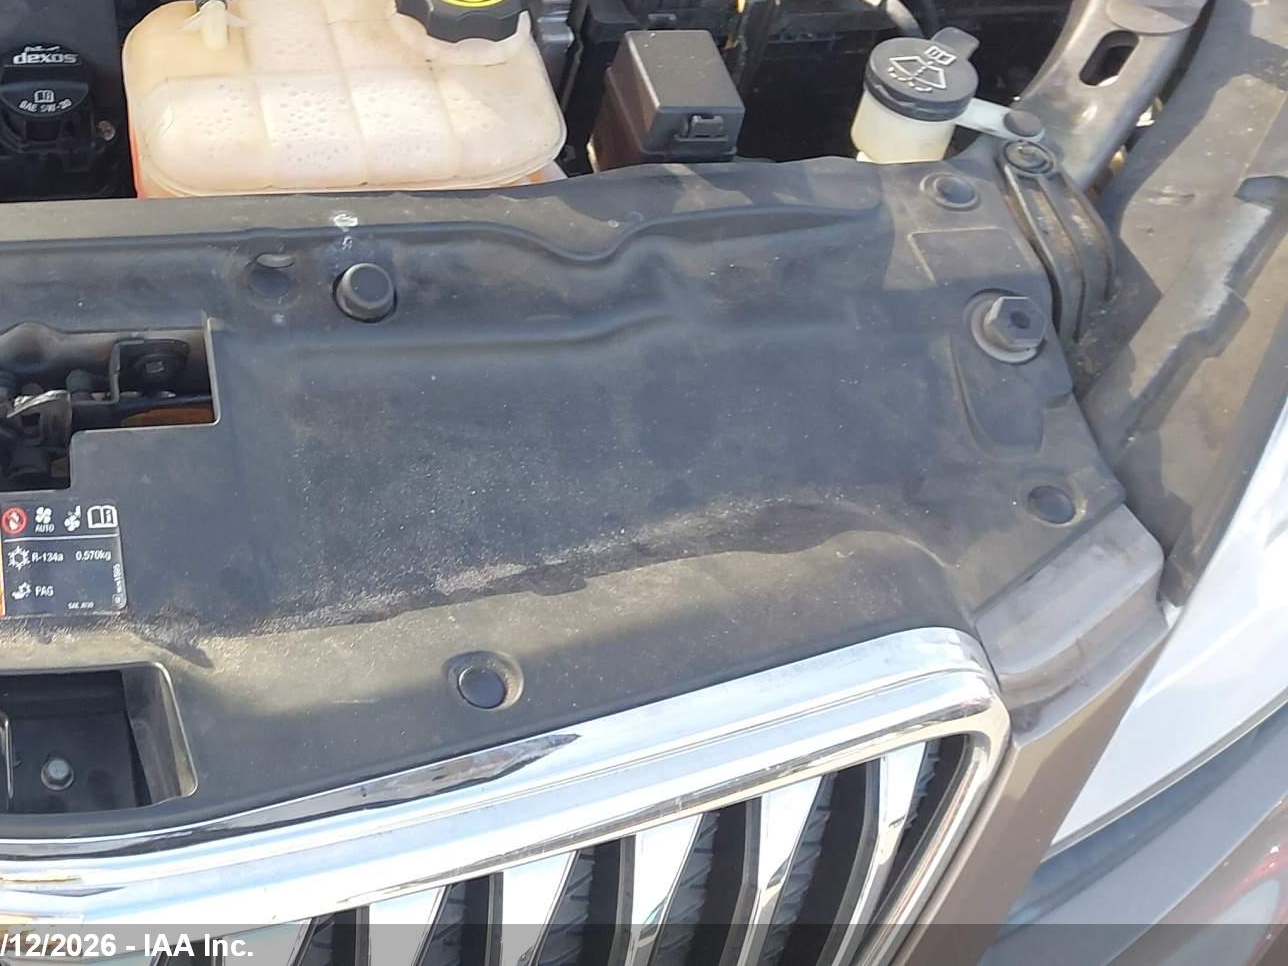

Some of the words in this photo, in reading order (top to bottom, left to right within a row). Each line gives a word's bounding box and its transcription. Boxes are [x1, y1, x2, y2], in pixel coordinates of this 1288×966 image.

[13, 51, 79, 65] dexos
[35, 523, 55, 533] AUTO
[31, 551, 64, 563] R-134a
[75, 549, 112, 562] 0.570kg
[35, 585, 54, 597] PAG
